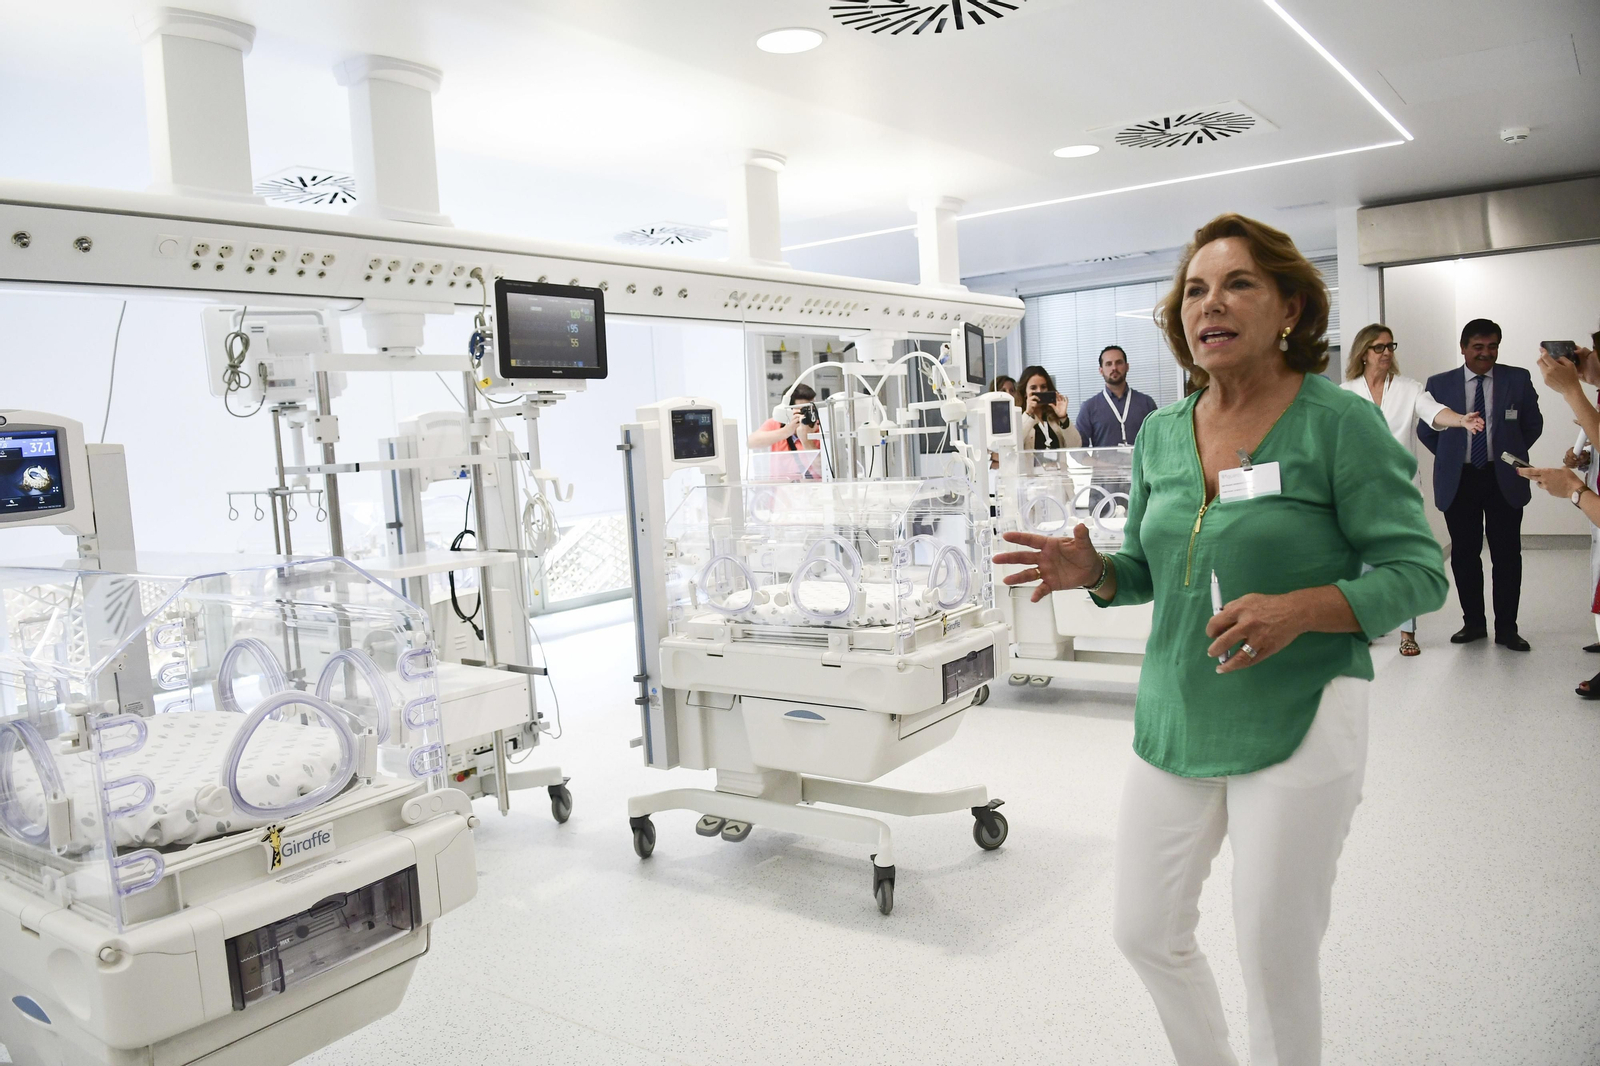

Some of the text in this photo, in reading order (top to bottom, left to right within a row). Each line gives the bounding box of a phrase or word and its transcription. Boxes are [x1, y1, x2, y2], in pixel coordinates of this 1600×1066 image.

[570, 338, 580, 347] 55
[30, 442, 53, 453] 37,1
[946, 620, 960, 631] Giraffe
[281, 830, 331, 857] Giraffe
